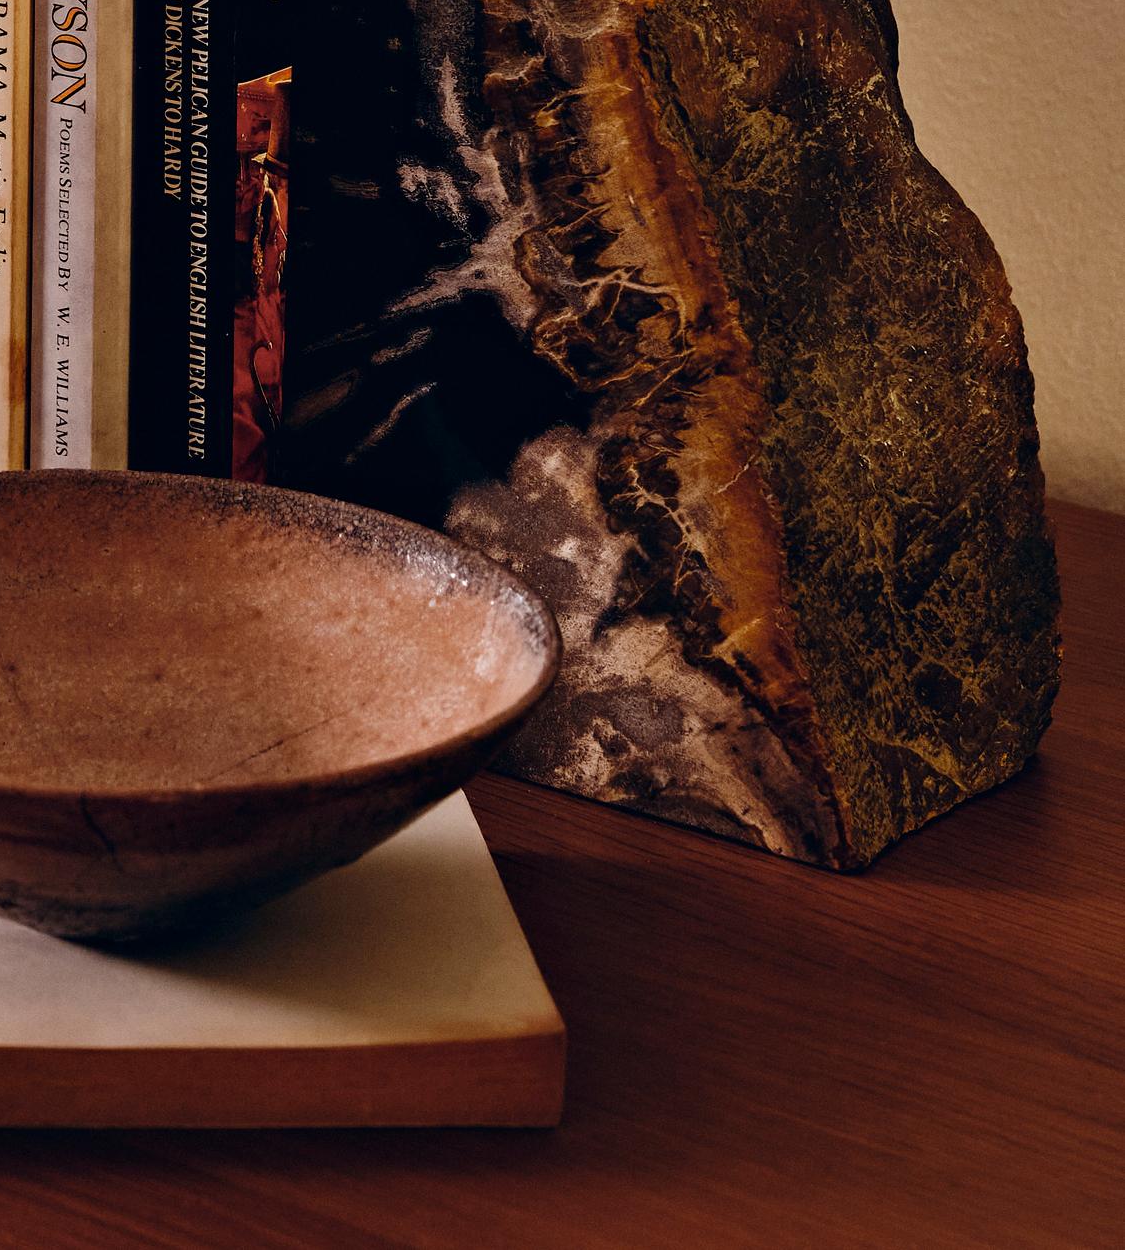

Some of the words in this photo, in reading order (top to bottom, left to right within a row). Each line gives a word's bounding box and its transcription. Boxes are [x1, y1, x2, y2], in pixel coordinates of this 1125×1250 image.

[165, 4, 183, 92] DICKENS
[164, 96, 182, 124] TO
[191, 48, 209, 139] PELICAN
[59, 117, 73, 174] POEMS
[164, 125, 182, 201] HARDY
[190, 141, 208, 207] GUIDE
[58, 177, 72, 262] SELECTED
[190, 210, 207, 238] TO
[57, 266, 71, 291] BY
[189, 241, 207, 328] ENGLISH
[56, 333, 70, 351] E.
[57, 306, 70, 327] W.
[55, 359, 70, 457] WILLIAMS
[188, 331, 206, 459] LITERATURE
